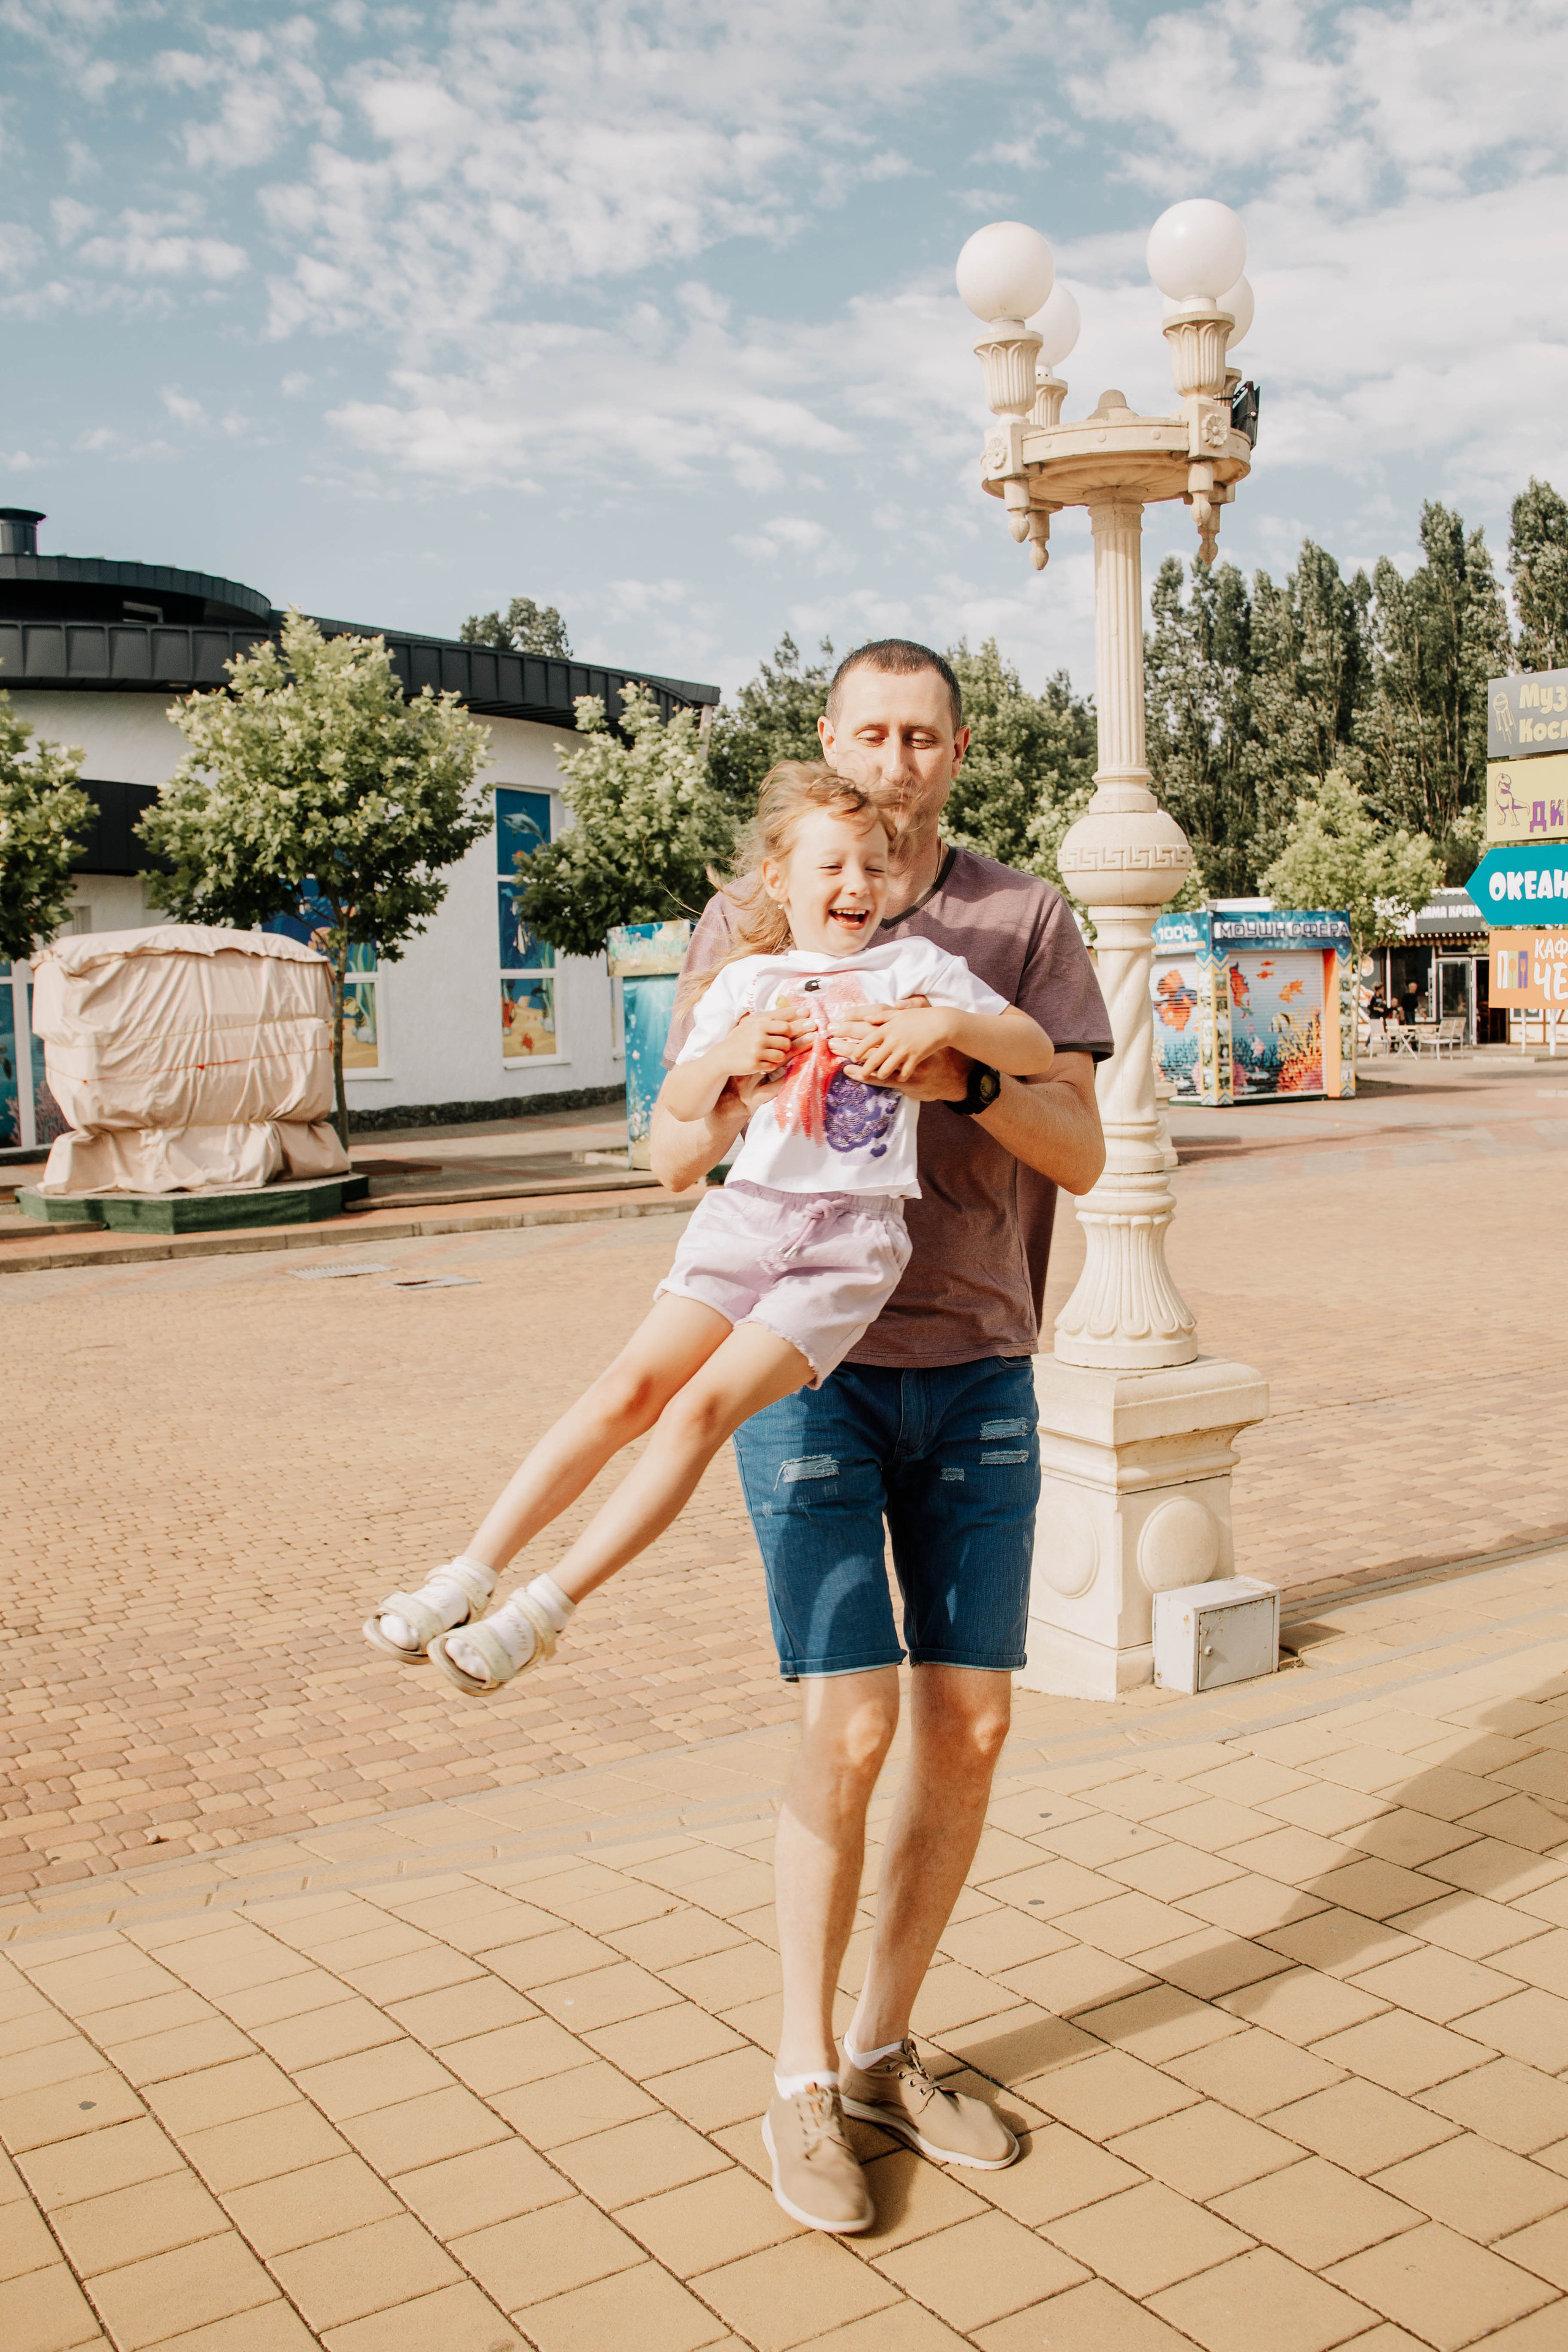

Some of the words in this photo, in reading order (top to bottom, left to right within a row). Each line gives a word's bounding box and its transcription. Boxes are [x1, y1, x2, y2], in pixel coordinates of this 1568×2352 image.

[1519, 682, 1567, 715] Муз
[1529, 799, 1568, 832] ДИ
[1489, 869, 1568, 901] ОКЕАН
[1157, 925, 1198, 940] 100%
[1286, 921, 1350, 938] СФЕРА
[1534, 937, 1568, 959] КАФ
[1534, 962, 1568, 1001] ЧЕ
